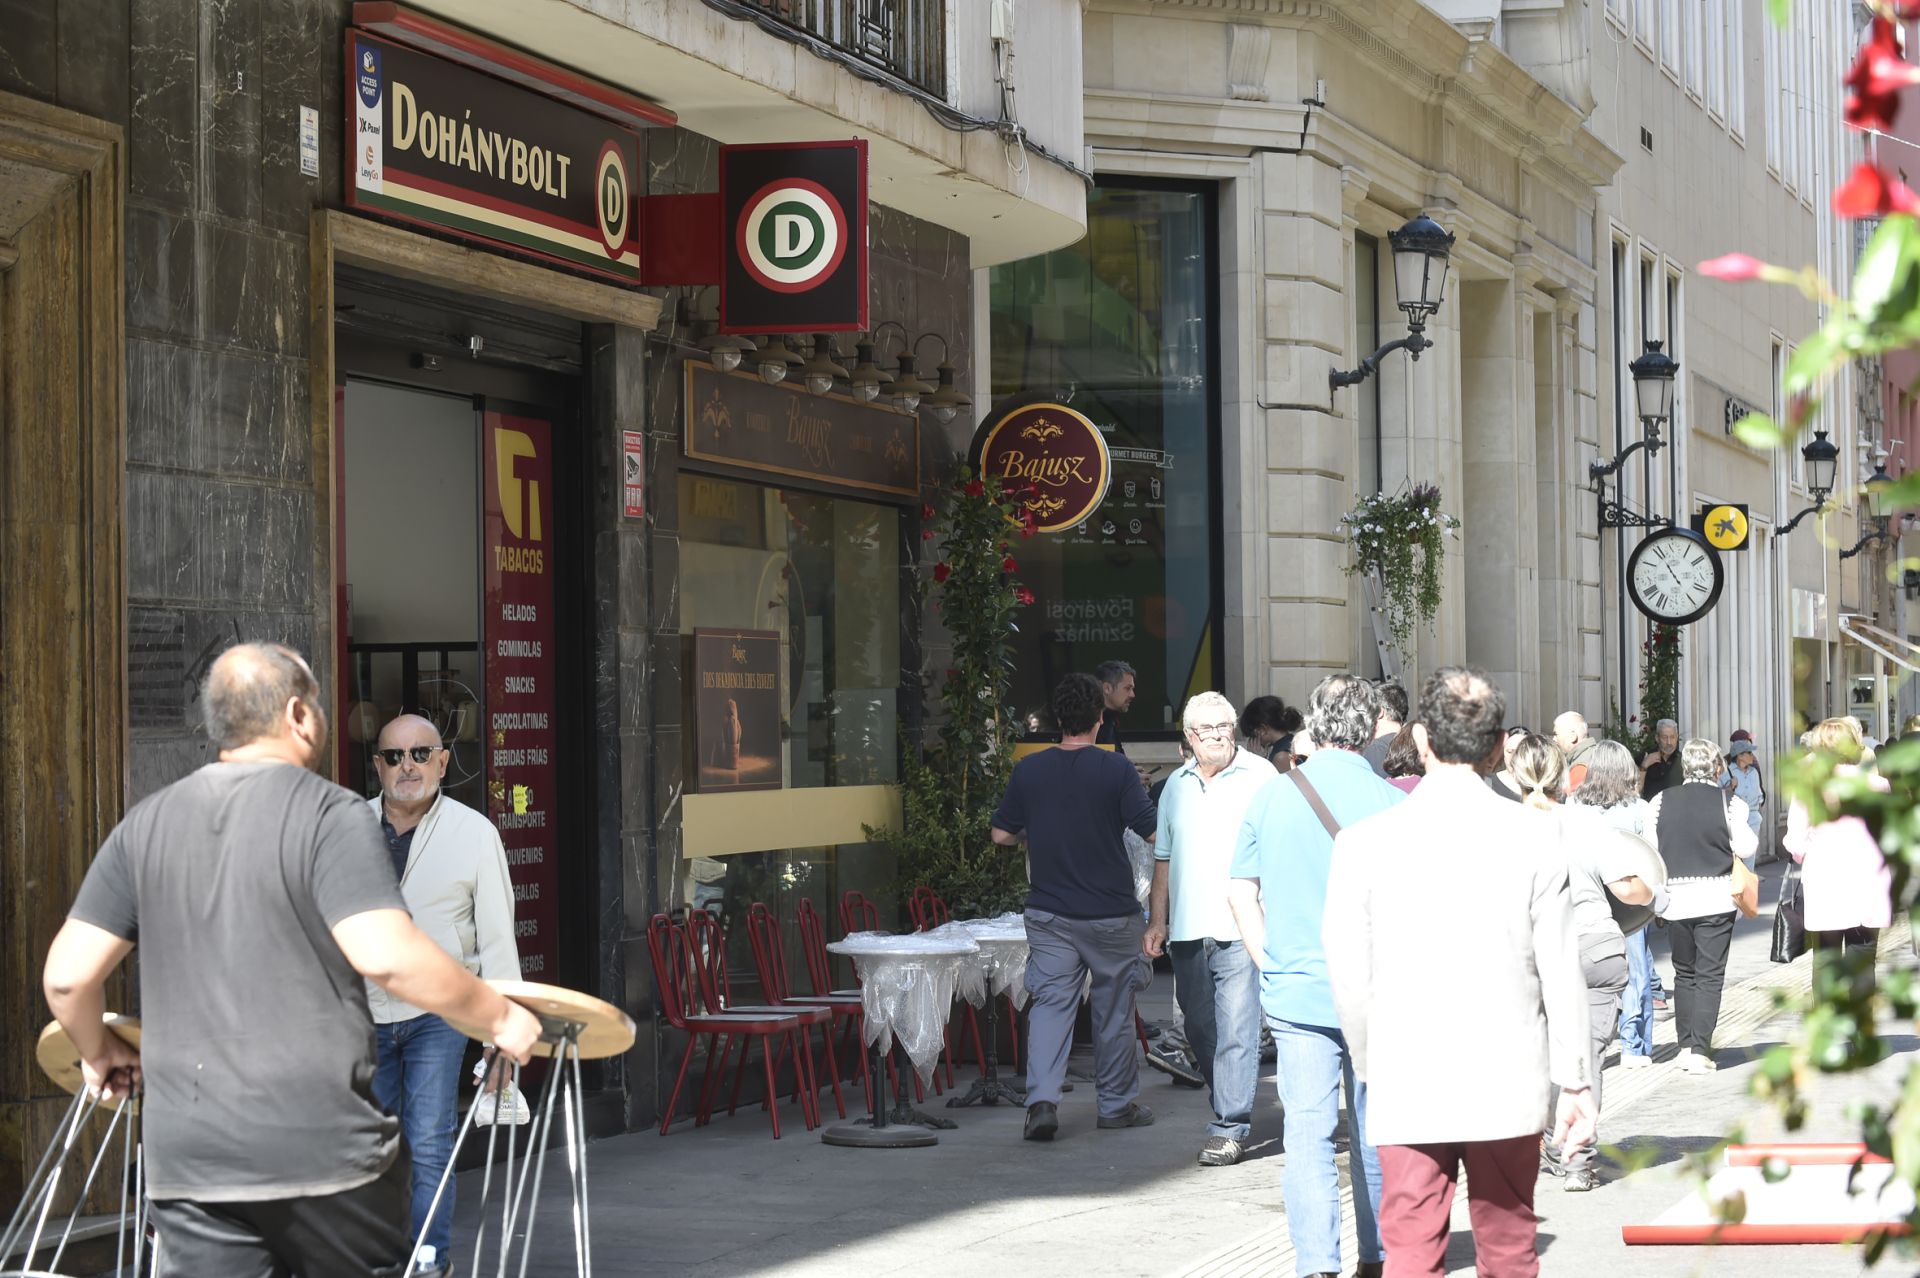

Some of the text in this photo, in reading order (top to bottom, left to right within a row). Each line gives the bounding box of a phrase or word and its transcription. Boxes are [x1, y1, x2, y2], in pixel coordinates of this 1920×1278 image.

[361, 75, 377, 88] ACCESS
[362, 85, 376, 97] POINT
[607, 176, 621, 223] D
[774, 214, 815, 258] D
[1131, 450, 1158, 461] BURGERS
[999, 450, 1093, 487] Bajusz
[495, 546, 543, 574] TABACOS
[502, 604, 537, 622] HELADOS
[498, 639, 542, 658] GOMINOLAS
[505, 676, 535, 694] SNACKS
[492, 712, 548, 731] CHOCOLATINAS
[493, 745, 548, 767] BEBIDAS FRÍAS
[497, 811, 546, 829] TRANSPORTE
[505, 846, 544, 866] OUVENIRS
[514, 919, 538, 938] APERS
